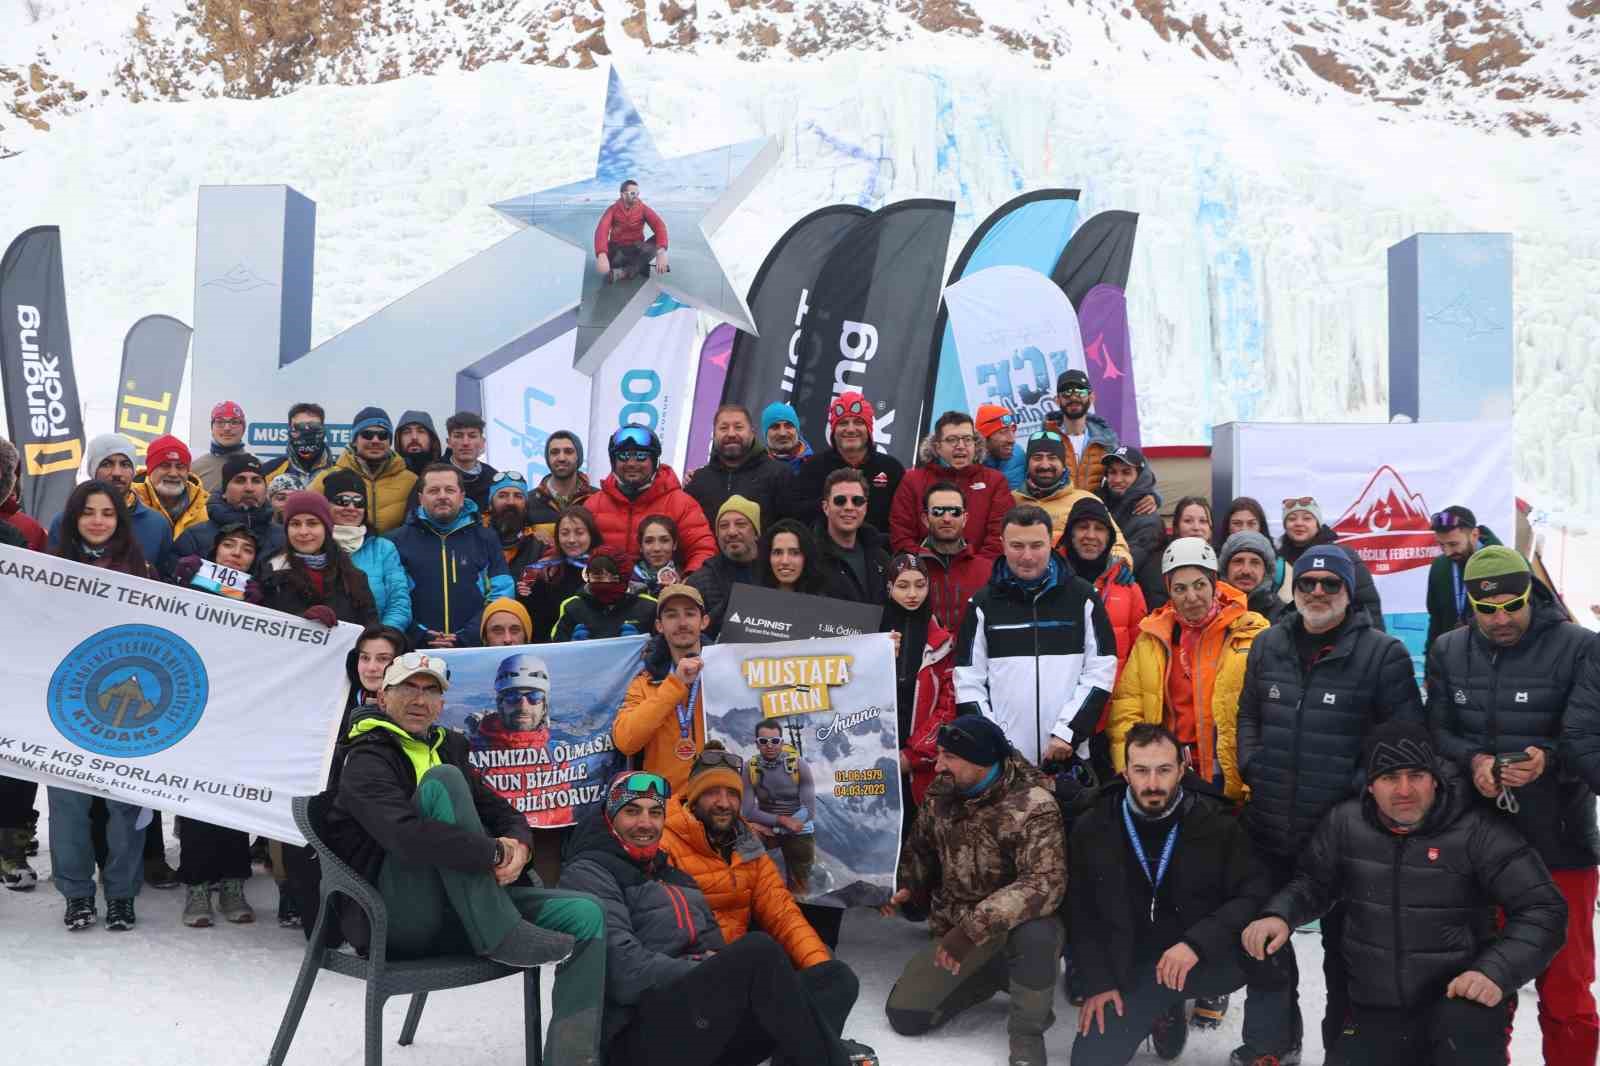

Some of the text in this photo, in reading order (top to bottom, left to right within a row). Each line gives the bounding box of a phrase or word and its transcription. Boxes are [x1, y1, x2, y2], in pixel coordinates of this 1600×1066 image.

[17, 304, 48, 438] singing
[42, 354, 70, 436] rock
[211, 565, 239, 587] 146
[0, 560, 113, 598] KARADENİZ
[117, 587, 190, 617] TEKNİK
[195, 603, 331, 646] ÜNİVERSİTESİ
[743, 616, 793, 632] ALPINIST
[747, 659, 850, 685] MUSTAFA
[22, 742, 48, 757] VE
[51, 749, 85, 767] KIŞ
[89, 758, 190, 790] SPORLARI
[193, 779, 273, 803] KULÜBÜ
[468, 747, 550, 769] ANIMIZDA
[484, 763, 588, 792] NUN BİZİMLE
